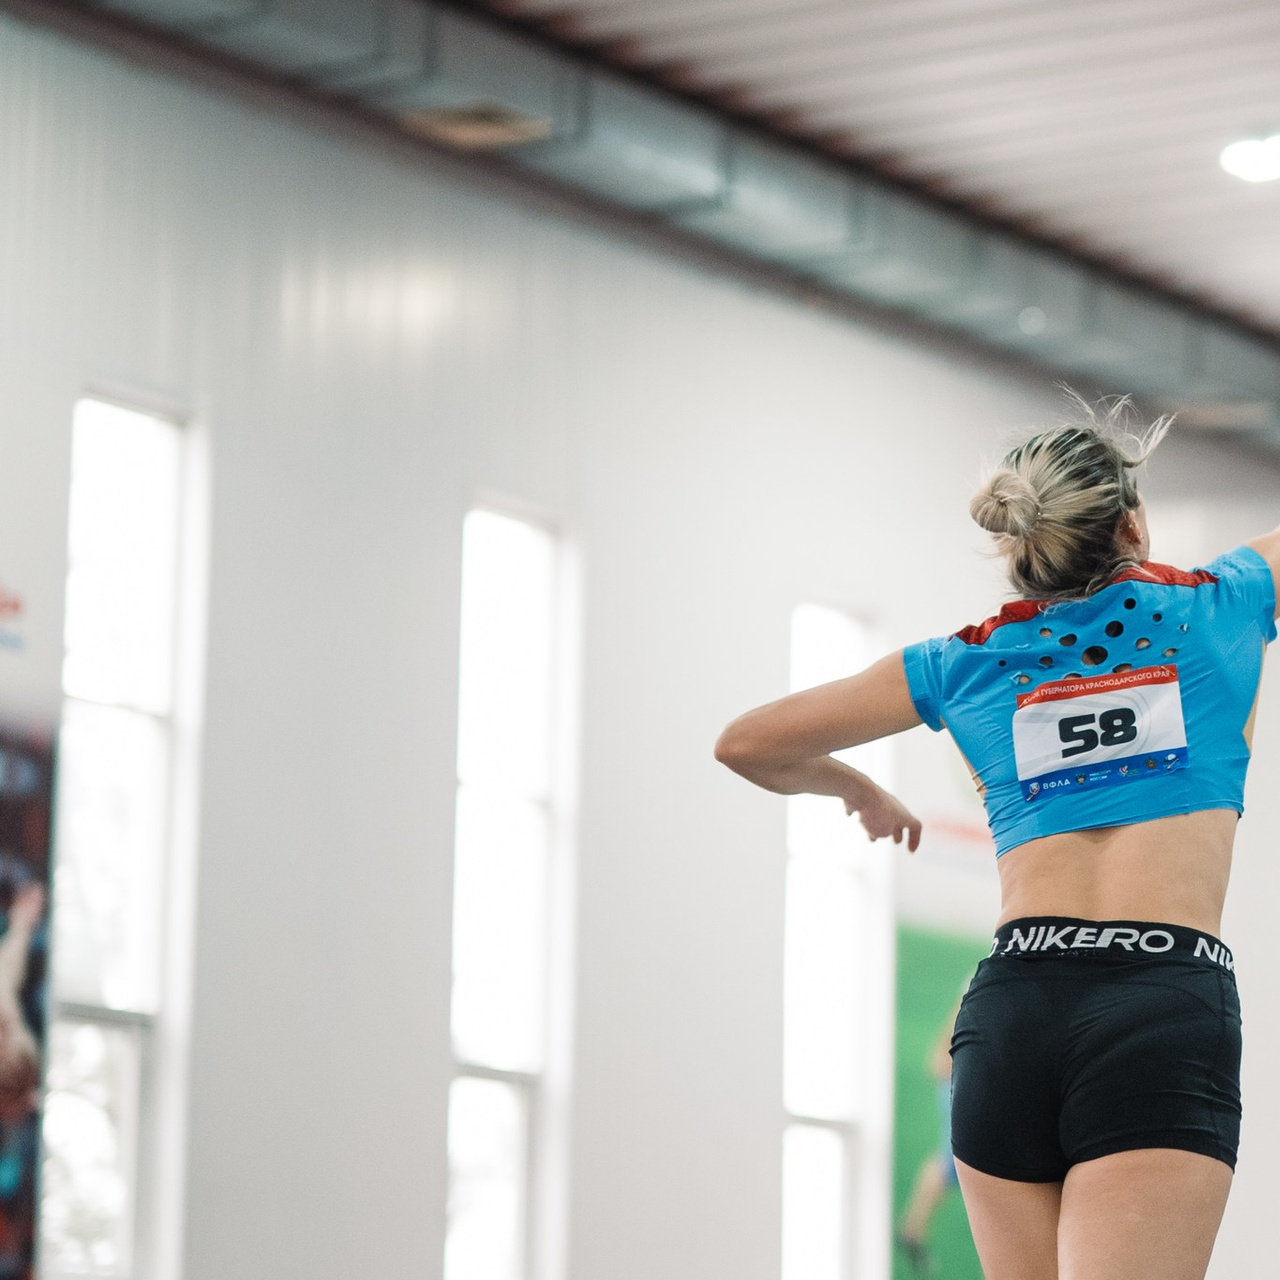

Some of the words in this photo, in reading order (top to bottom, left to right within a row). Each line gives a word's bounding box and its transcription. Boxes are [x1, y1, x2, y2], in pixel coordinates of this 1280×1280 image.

[1041, 684, 1084, 697] ГУБЕРНАТОРА
[1086, 671, 1152, 690] КРАСНОДАРСКОГО
[1153, 669, 1170, 679] КРАЯ
[1058, 707, 1137, 759] 58
[1042, 778, 1071, 790] ВФЛА
